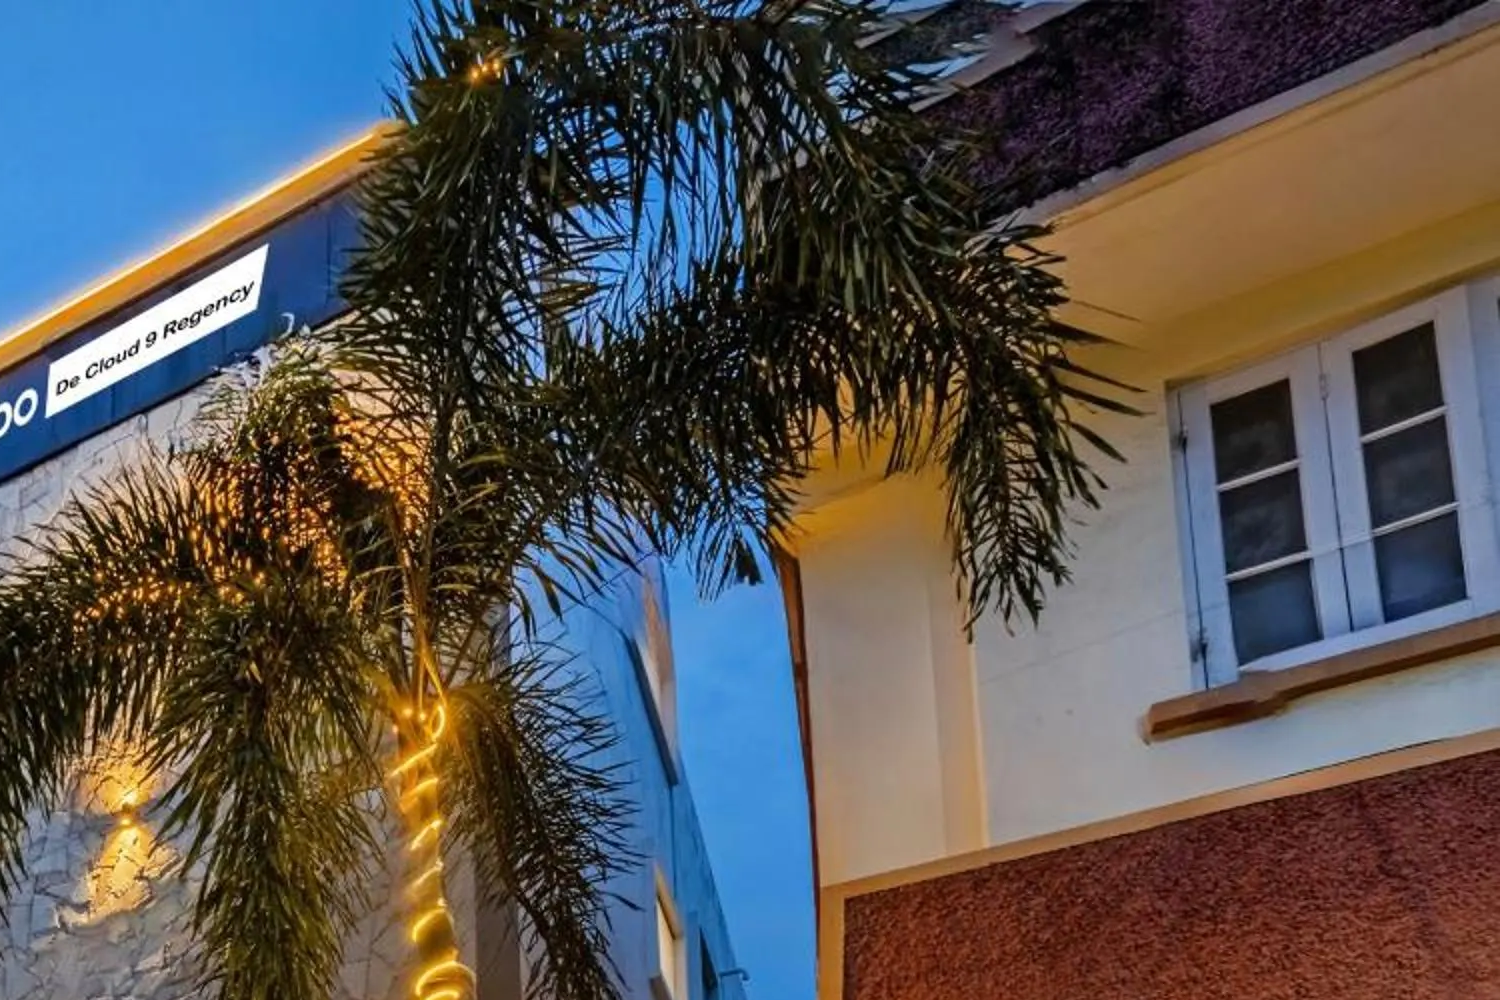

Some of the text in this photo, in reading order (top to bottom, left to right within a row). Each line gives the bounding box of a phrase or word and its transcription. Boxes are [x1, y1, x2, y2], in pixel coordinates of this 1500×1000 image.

[55, 280, 255, 397] De Cloud 9 Regency
